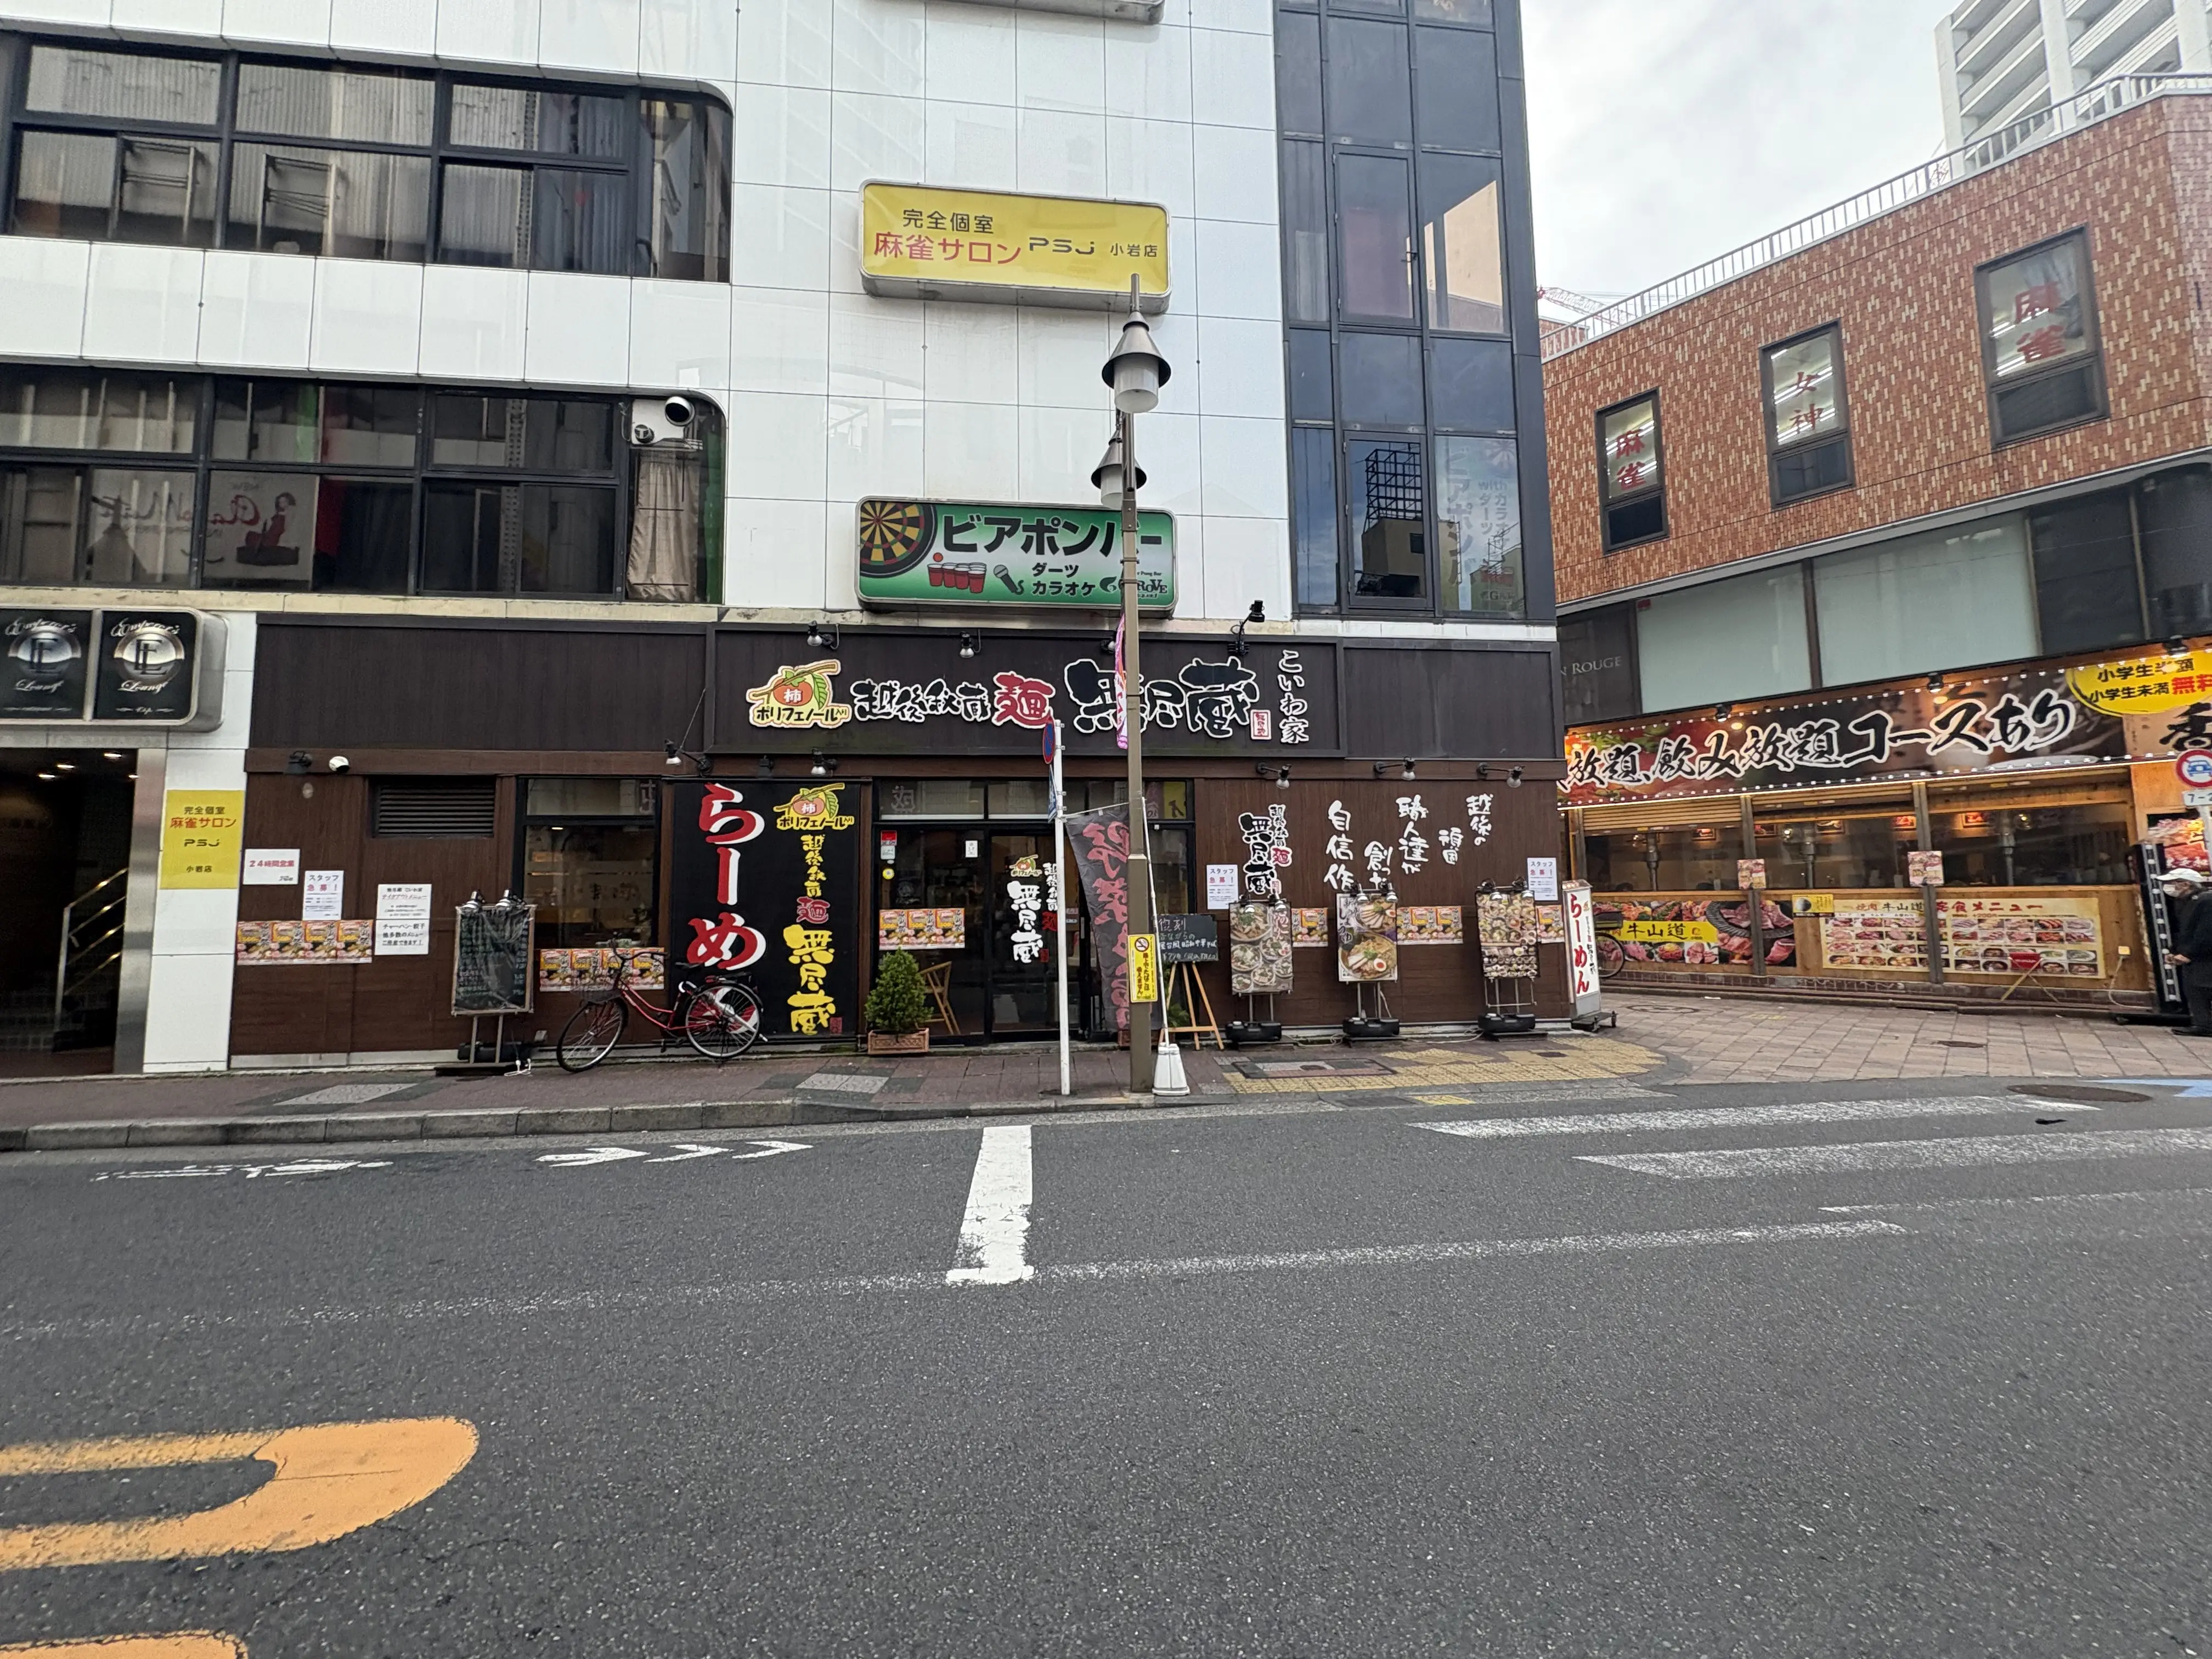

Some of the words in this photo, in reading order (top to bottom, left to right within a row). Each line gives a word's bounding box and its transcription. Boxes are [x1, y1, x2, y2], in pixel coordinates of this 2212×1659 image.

[903, 209, 994, 234] 完全個室
[873, 231, 1022, 265] 麻雀サロン
[1110, 242, 1158, 258] 小岩店
[2015, 280, 2066, 364] 麻雀
[1789, 371, 1823, 438] 女神
[1615, 429, 1646, 492] 麻雀
[1031, 562, 1079, 578] ダーツ
[1031, 579, 1097, 596] カラオケ
[1119, 579, 1168, 594] ROVE
[1572, 656, 1622, 675] ROUGE
[783, 688, 803, 703] 柿
[1278, 650, 1310, 744] こいわ家
[184, 806, 225, 815] 完全個室
[801, 803, 817, 814] 柿
[170, 816, 237, 830] 麻雀サロン
[1324, 800, 1355, 891] 自信作
[186, 865, 213, 873] 小岩店
[1627, 922, 1688, 940] 牛山道
[1570, 893, 1590, 995] らーめん
